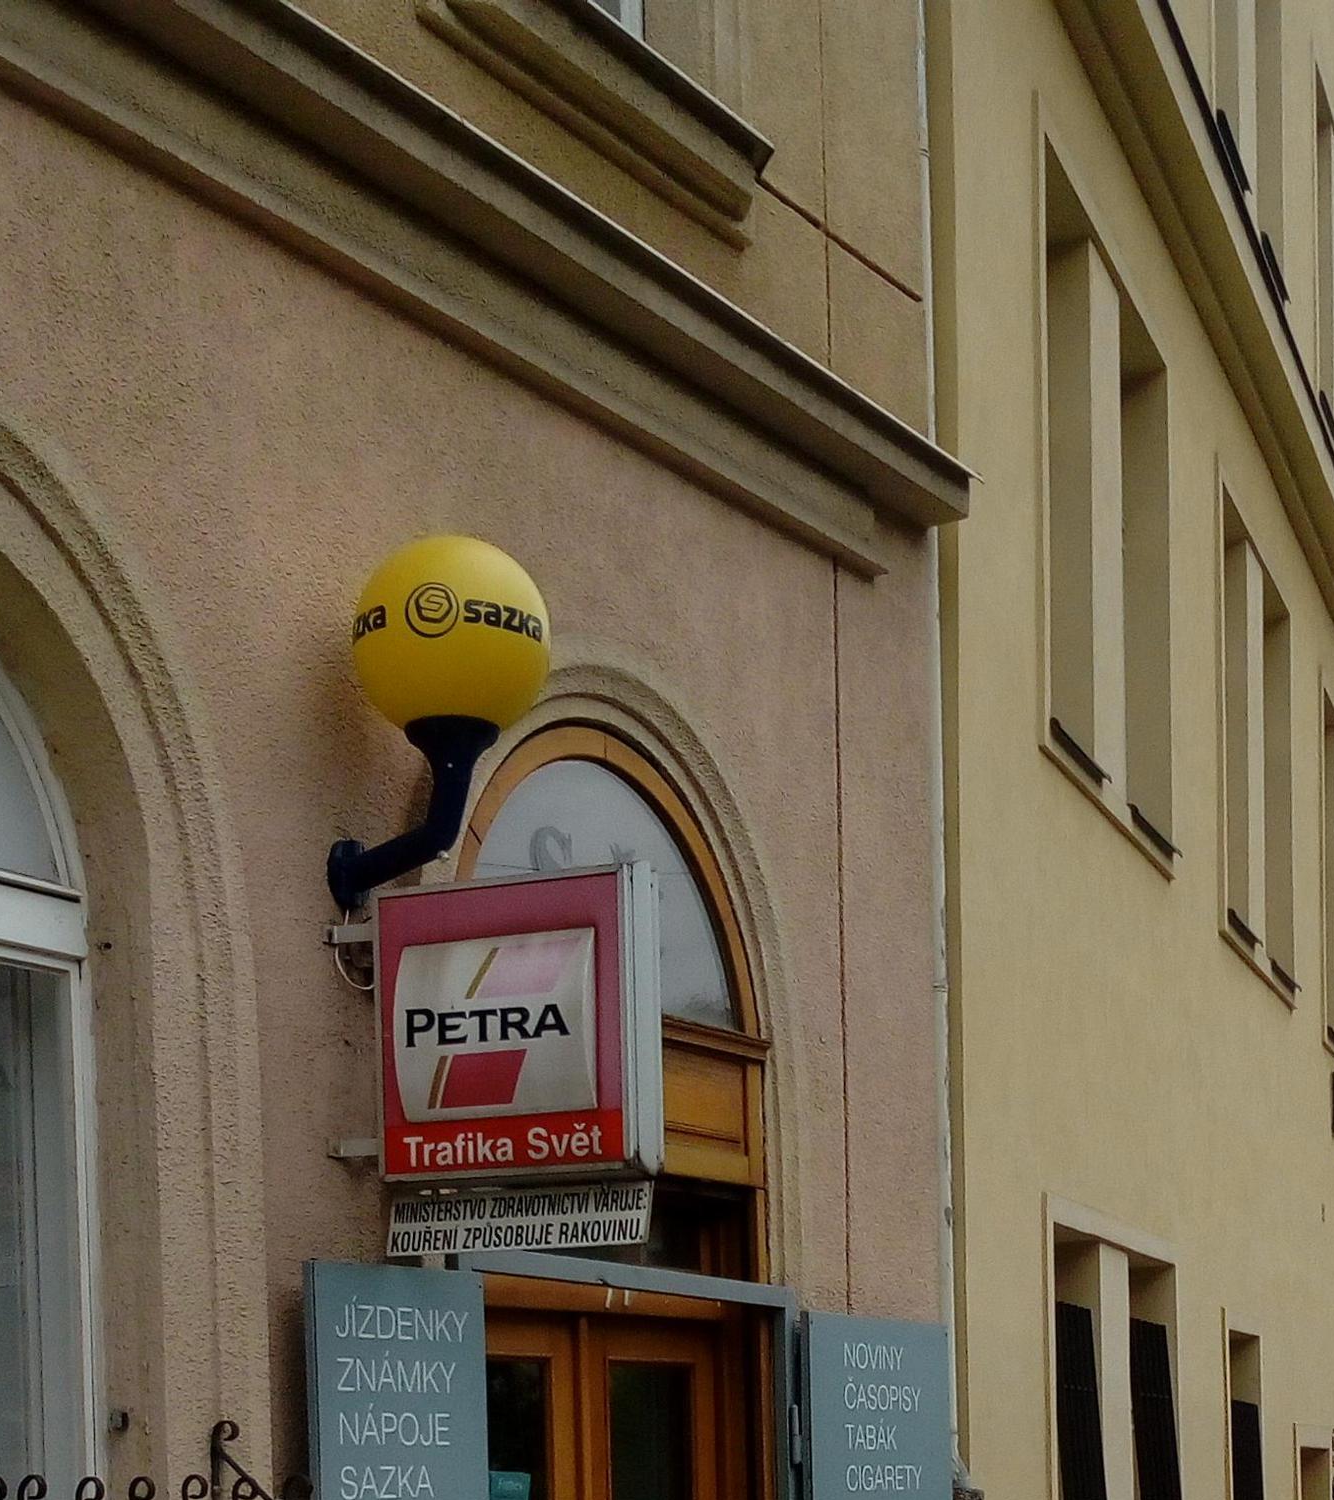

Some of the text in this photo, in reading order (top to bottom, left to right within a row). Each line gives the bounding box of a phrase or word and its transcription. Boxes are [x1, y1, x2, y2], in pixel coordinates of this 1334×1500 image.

[405, 1003, 571, 1048] PETRA
[403, 1122, 603, 1167] Trafika Svět
[394, 1196, 486, 1224] MINISTERSTVO
[391, 1217, 643, 1253] KOUŘENÍ ZPŮSOBUJE RAKOVINU.
[335, 1296, 469, 1342] JÍZDENKY
[336, 1350, 456, 1394] ZNÁMKY
[843, 1341, 904, 1371] NOVINY
[844, 1375, 921, 1412] ČASOPISY
[339, 1402, 451, 1446] NÁPOJE
[844, 1417, 898, 1450] TABÁK
[340, 1464, 435, 1500] SAZKA
[846, 1464, 922, 1492] CIGARETY
